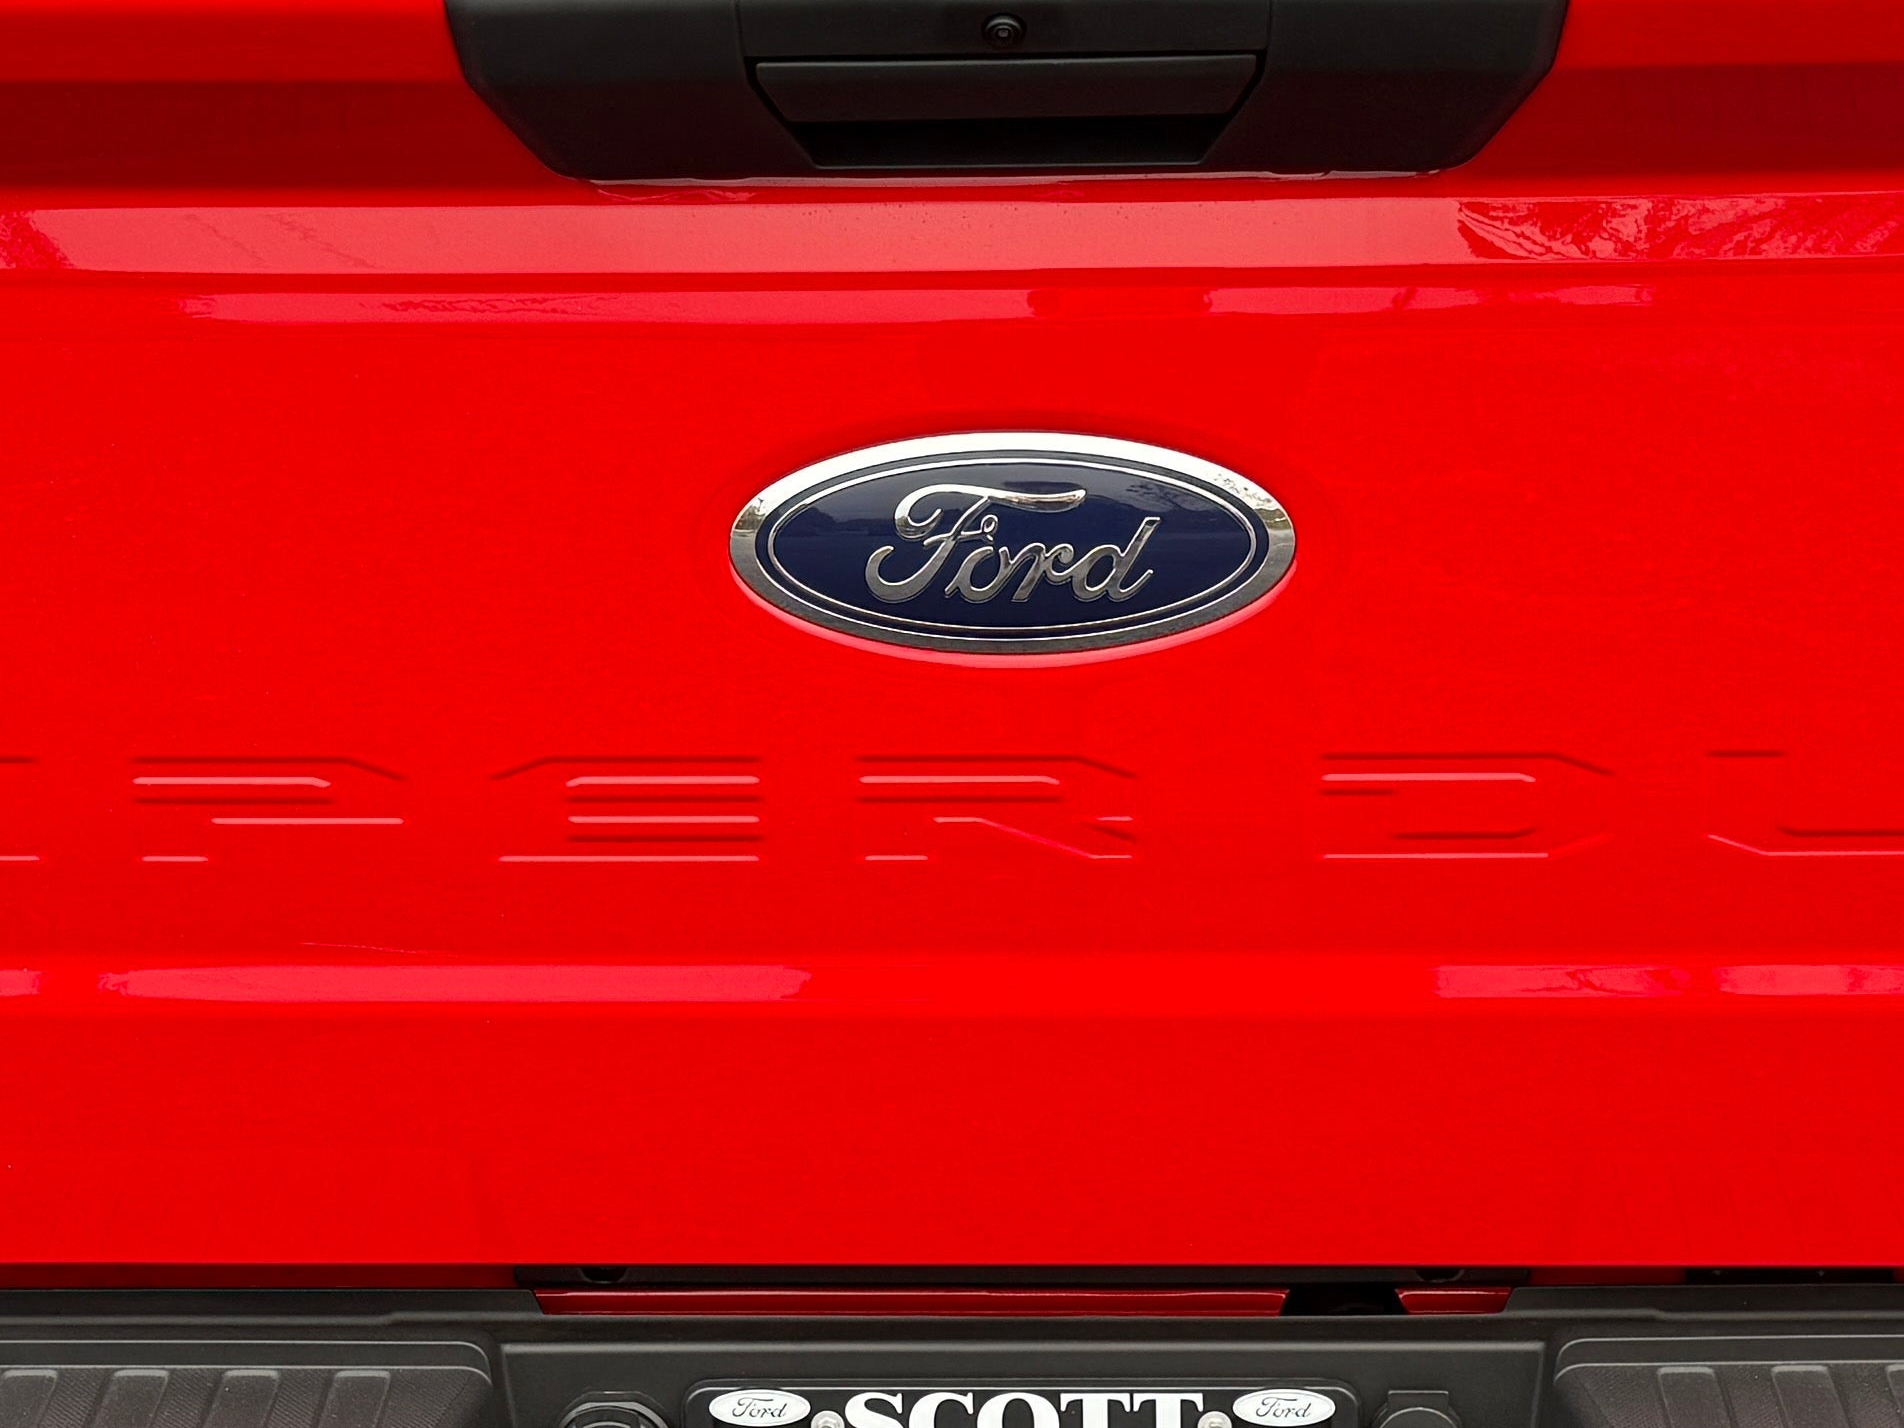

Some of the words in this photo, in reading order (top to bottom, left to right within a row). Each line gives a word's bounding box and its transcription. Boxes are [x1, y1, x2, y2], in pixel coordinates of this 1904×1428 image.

[865, 483, 1161, 604] Ford
[732, 1397, 788, 1419] Ford
[1256, 1397, 1312, 1419] Ford
